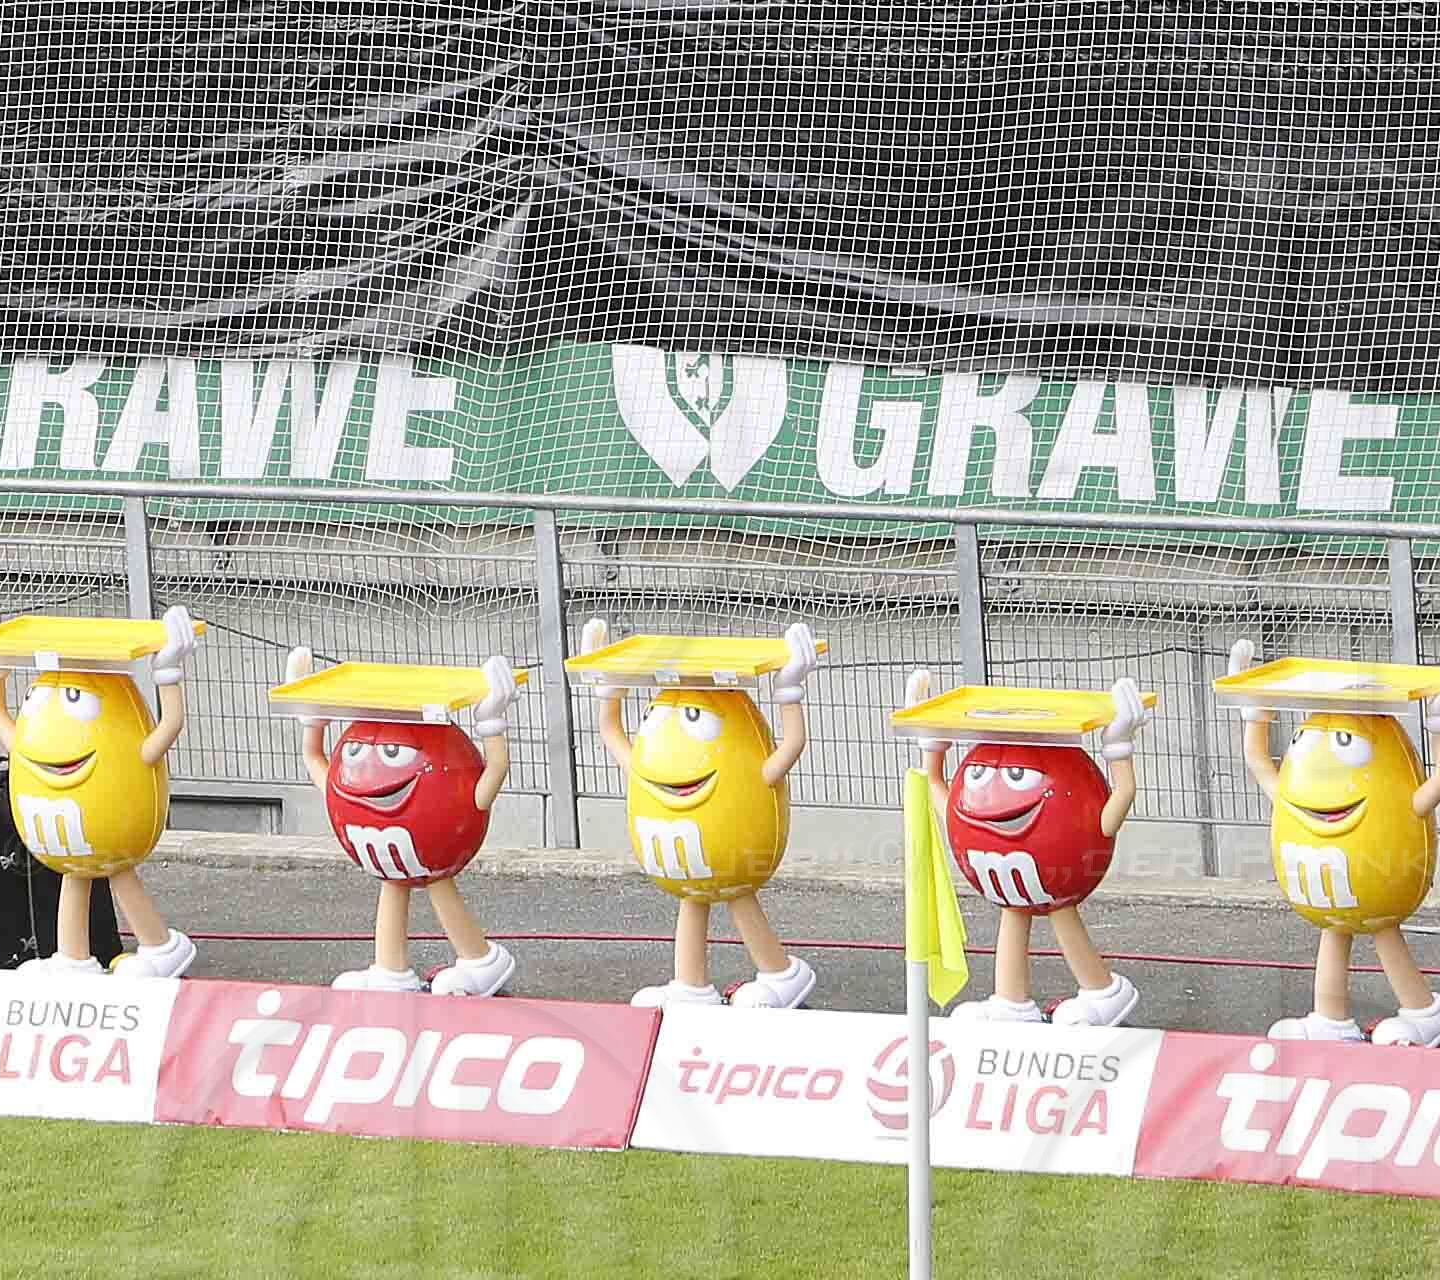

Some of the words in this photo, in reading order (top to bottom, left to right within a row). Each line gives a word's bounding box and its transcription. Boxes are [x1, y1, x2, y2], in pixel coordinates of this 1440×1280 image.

[815, 361, 1401, 513] GRAWE
[17, 795, 93, 856] m
[346, 824, 431, 879] m
[634, 817, 712, 880] m
[967, 850, 1054, 906] m
[1278, 844, 1358, 909] m
[6, 1000, 140, 1032] BUNDES
[228, 989, 585, 1123] tipico
[678, 1047, 844, 1105] tipico
[977, 1048, 1121, 1083] BUNDES
[965, 1082, 1109, 1137] LIGA
